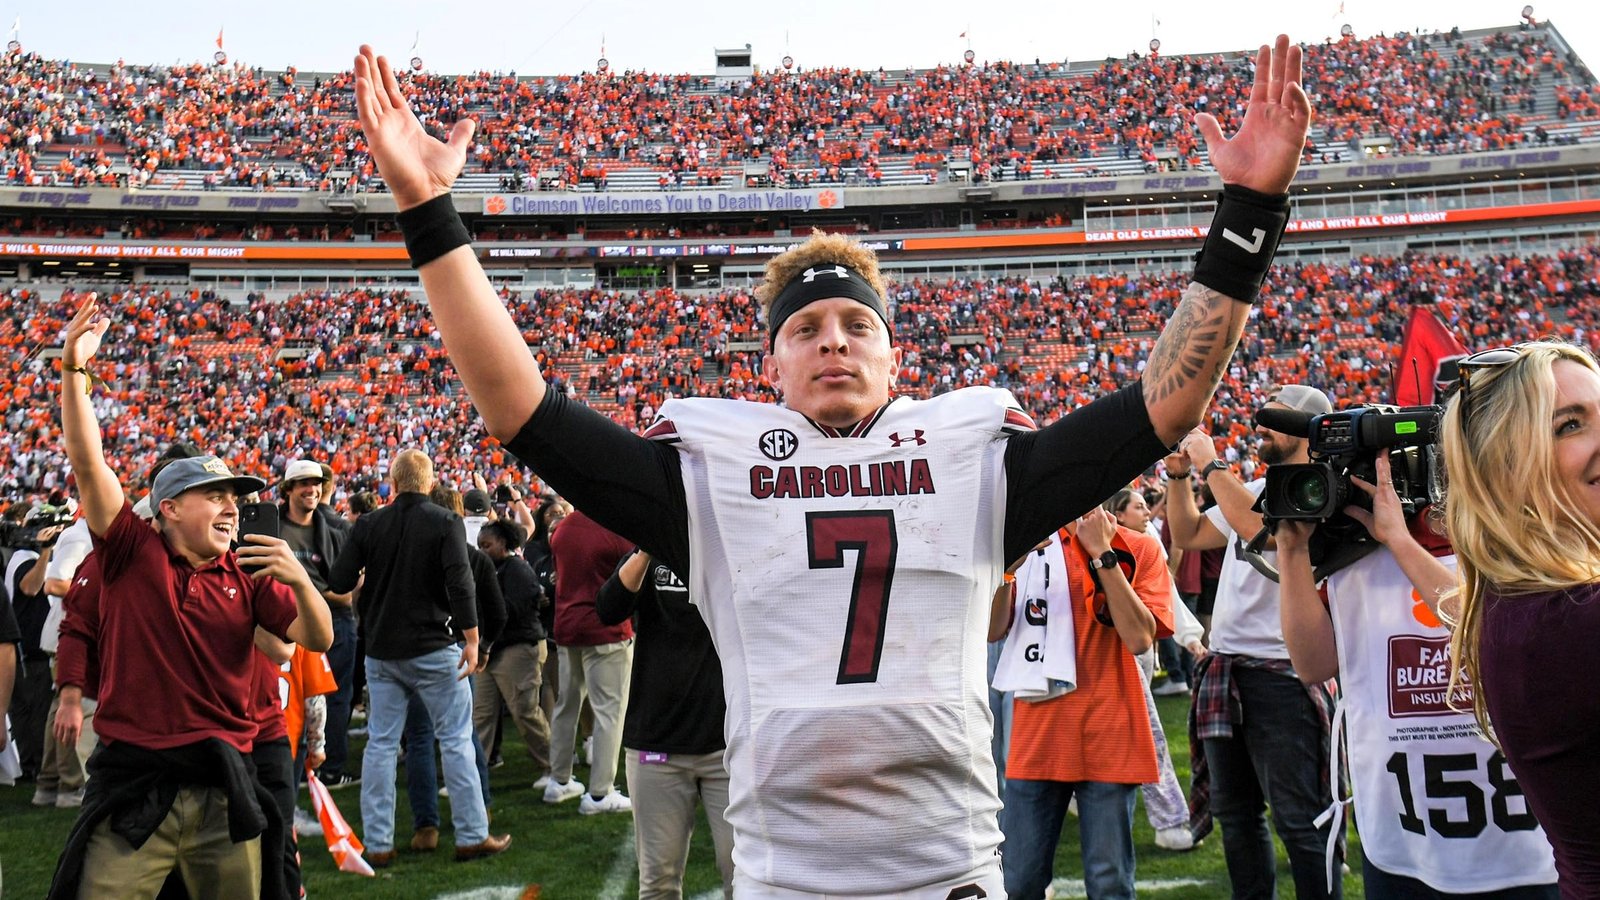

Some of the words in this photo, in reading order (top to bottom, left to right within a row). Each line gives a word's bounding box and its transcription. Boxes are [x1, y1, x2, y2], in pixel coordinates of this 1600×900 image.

[512, 196, 577, 213] Clemson
[582, 195, 662, 212] Welcomes
[665, 195, 692, 210] You
[698, 195, 712, 210] to
[718, 193, 761, 210] Death
[766, 191, 812, 210] Valley
[1302, 221, 1324, 230] AND
[1326, 218, 1356, 229] WITH
[1358, 216, 1379, 226] ALL
[1382, 214, 1407, 224] OUR
[1408, 212, 1447, 223] MIGHT
[896, 241, 903, 249] 7
[1085, 231, 1115, 241] DEAR
[1117, 230, 1138, 240] OLD
[1141, 228, 1196, 239] CLEMSON,
[1222, 227, 1266, 254] 7
[6, 244, 36, 254] WILL
[38, 245, 93, 255] TRIUMPH
[95, 246, 119, 255] AND
[122, 246, 154, 256] WITH
[155, 247, 177, 256] ALL
[180, 248, 205, 256] OUR
[207, 248, 245, 257] MIGHT
[761, 430, 796, 458] SEC
[750, 458, 935, 499] CAROLINA
[805, 509, 898, 685] 7
[1396, 726, 1438, 734] PHOTOGRAPHER
[1386, 750, 1540, 839] 158
